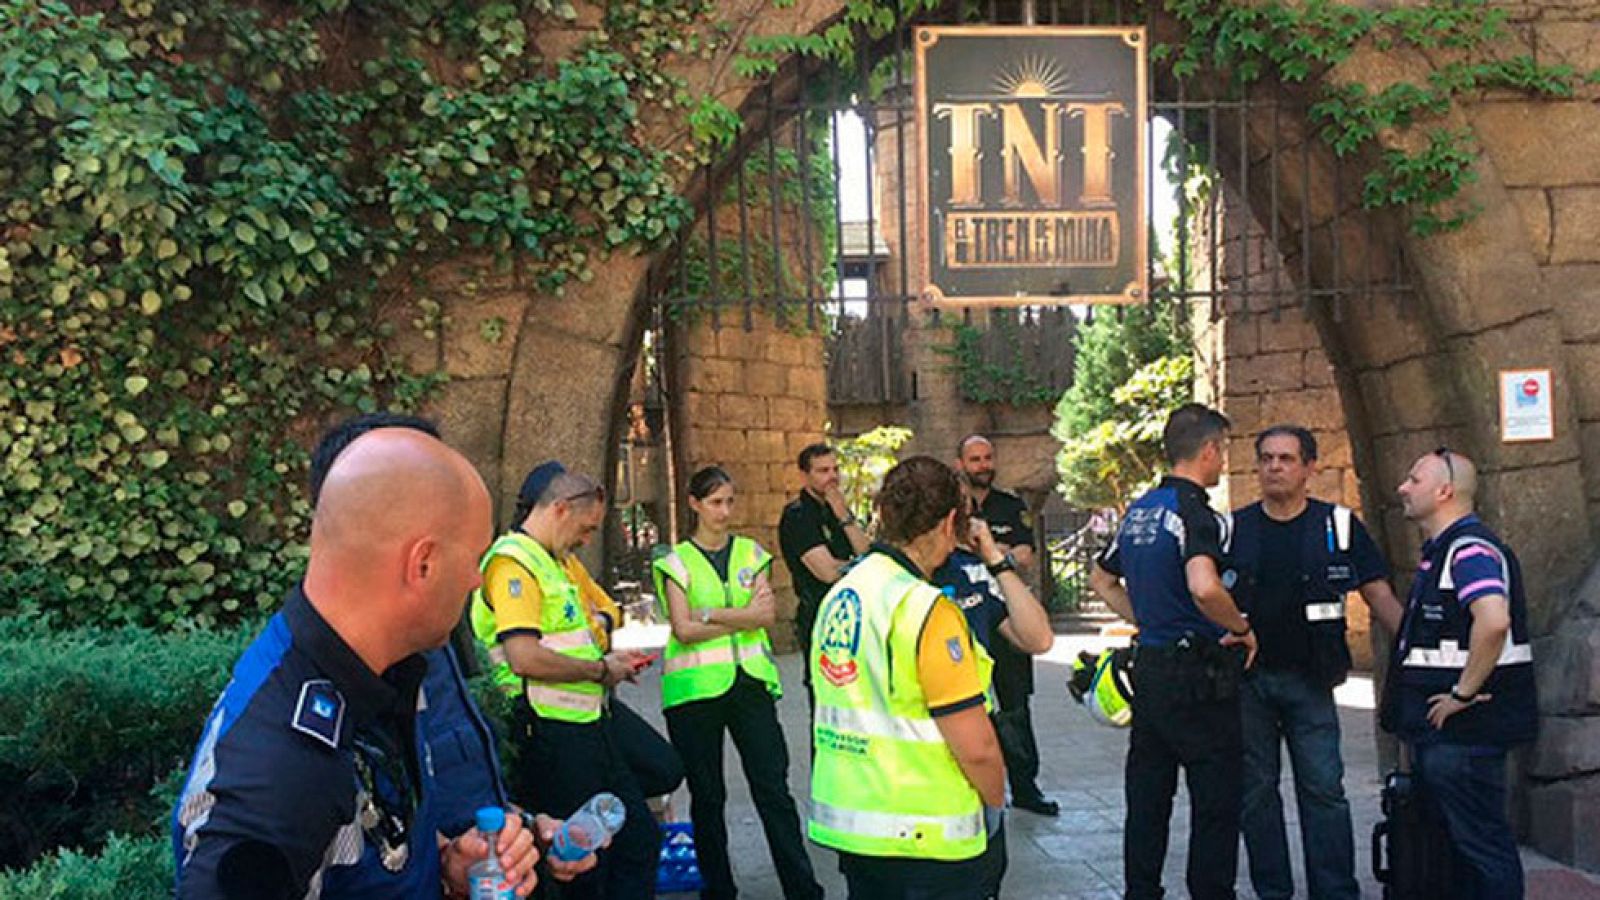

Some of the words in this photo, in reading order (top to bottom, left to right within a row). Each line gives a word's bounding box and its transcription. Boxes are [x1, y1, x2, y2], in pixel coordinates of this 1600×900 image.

[933, 101, 1131, 208] TNT
[971, 218, 1031, 263] TREN
[1055, 217, 1113, 263] MINA
